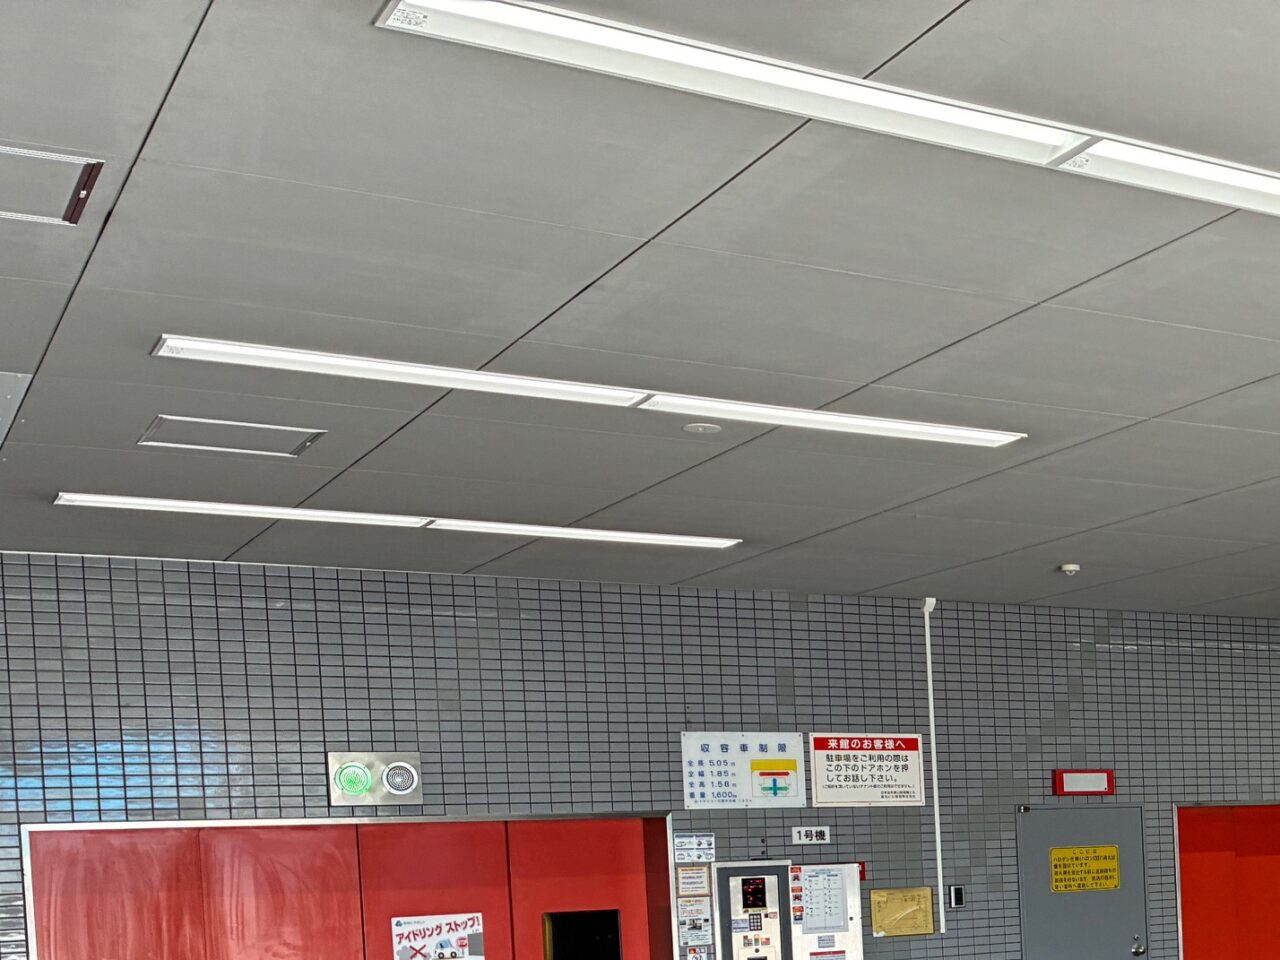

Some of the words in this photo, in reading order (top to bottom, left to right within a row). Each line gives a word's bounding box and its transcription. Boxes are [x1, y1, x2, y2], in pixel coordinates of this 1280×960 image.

[827, 738, 906, 749] 来館のお客様へ
[825, 754, 909, 763] 駐車場をご利用の際は
[825, 764, 909, 773] この下のドアホンを押
[826, 773, 898, 783] してお話し下さい。
[796, 830, 827, 842] 1号機
[396, 925, 443, 945] アイドリング
[445, 916, 480, 933] ストップ!
